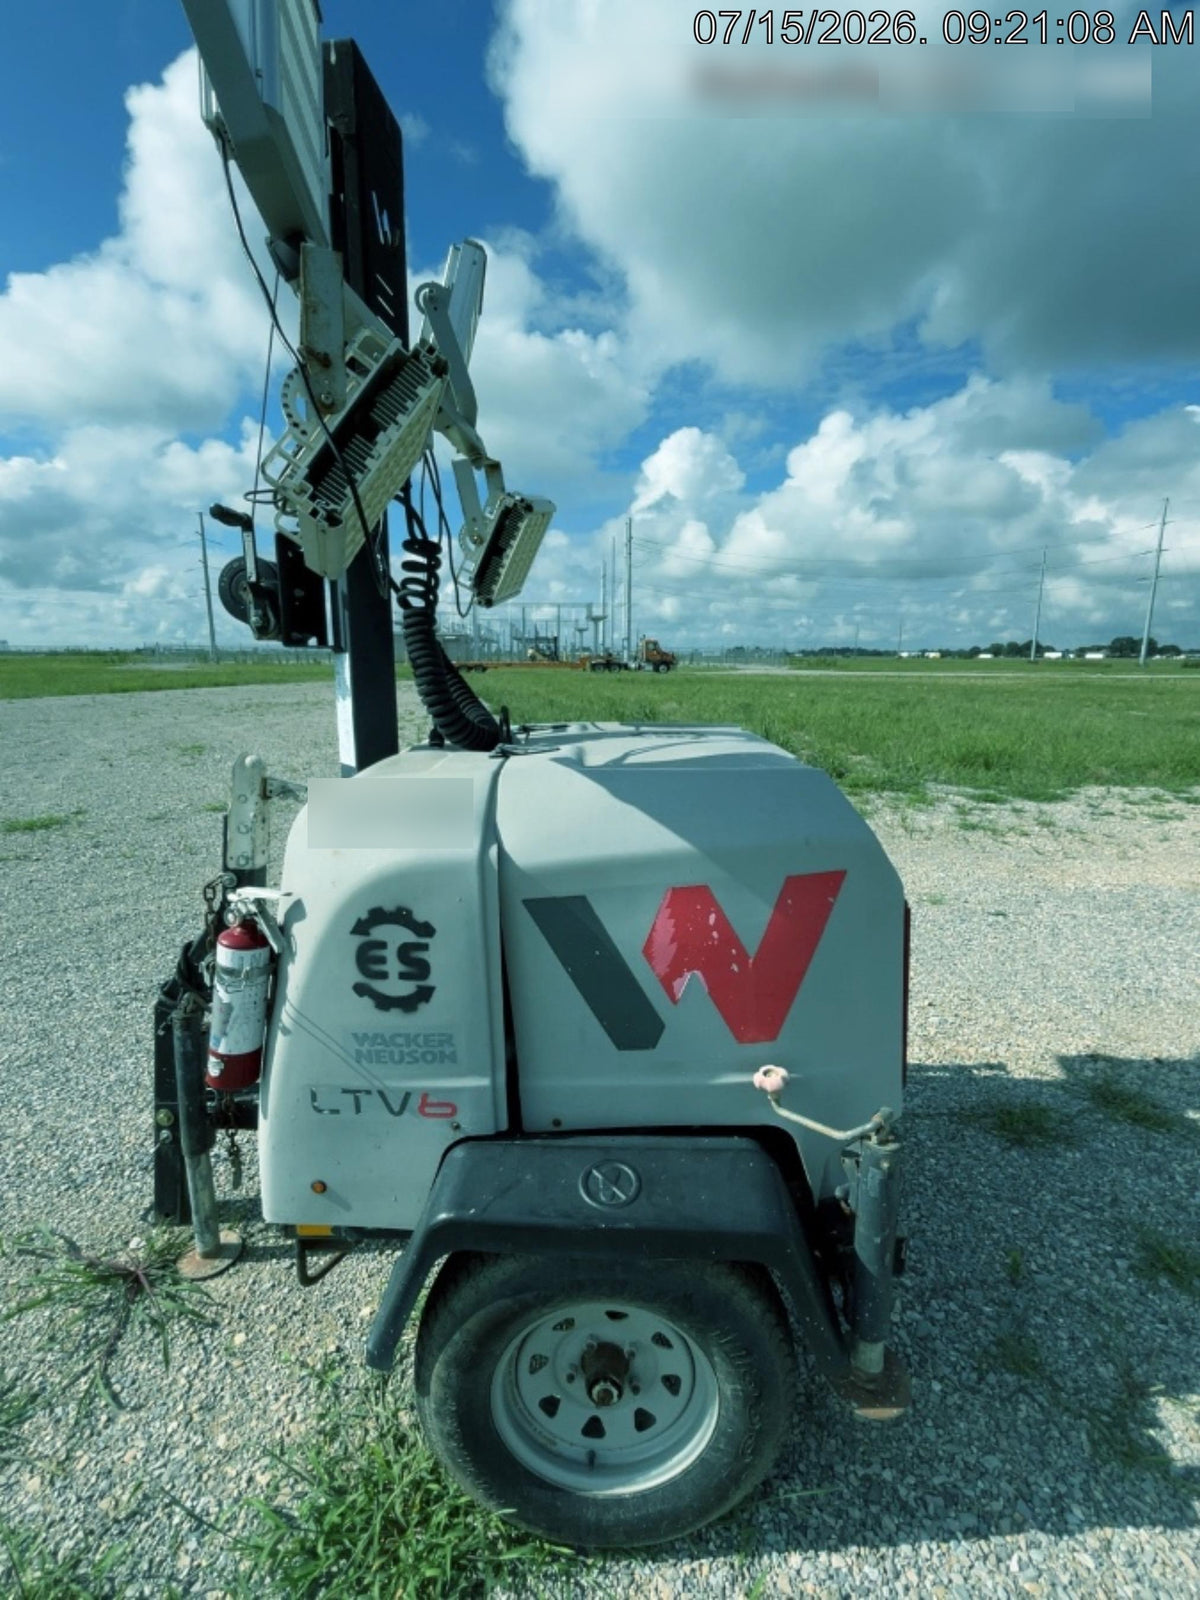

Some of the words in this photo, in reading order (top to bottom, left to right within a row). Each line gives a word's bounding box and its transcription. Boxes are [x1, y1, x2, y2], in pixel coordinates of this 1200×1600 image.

[355, 940, 431, 981] ES
[351, 1032, 455, 1049] WACKER
[354, 1049, 458, 1065] NEUSON
